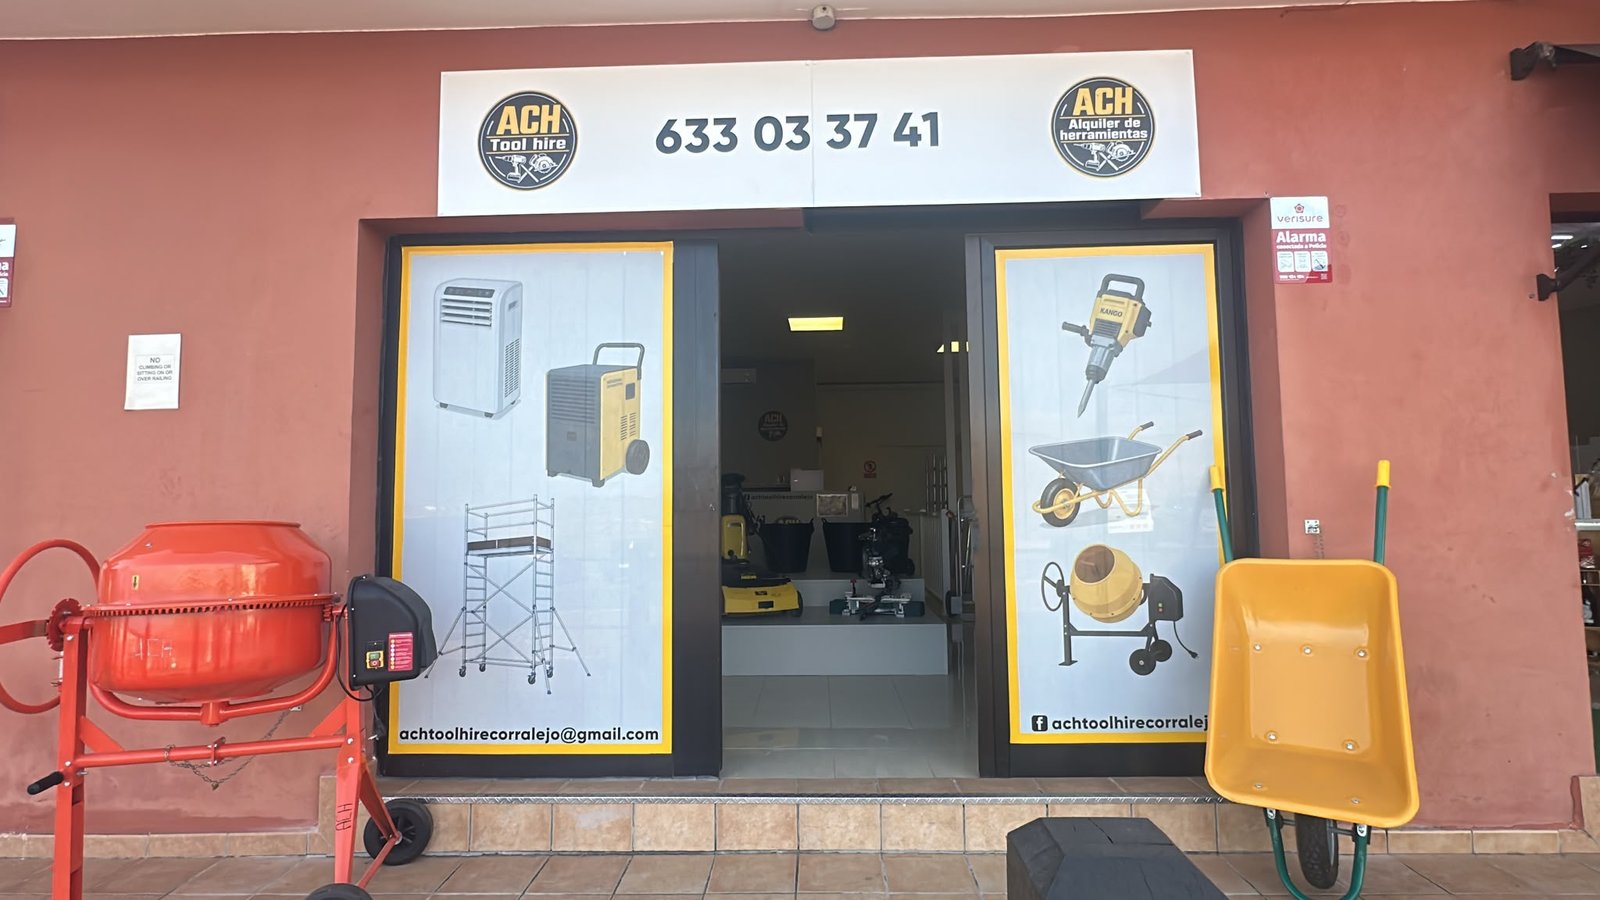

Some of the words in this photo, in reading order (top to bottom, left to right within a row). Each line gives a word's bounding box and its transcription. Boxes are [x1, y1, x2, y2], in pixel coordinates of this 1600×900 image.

[1072, 86, 1133, 116] ACH
[495, 104, 562, 135] ACH
[1068, 118, 1121, 131] Alquiler
[1124, 118, 1141, 128] de
[655, 117, 739, 154] 633
[754, 115, 811, 152] 03
[826, 113, 878, 150] 37
[893, 111, 939, 148] 41
[1059, 128, 1148, 140] herramientas
[489, 137, 527, 151] Tool
[532, 137, 567, 150] hire
[1276, 231, 1326, 243] Alarma
[1100, 307, 1123, 318] KANGO
[1052, 715, 1208, 732] achtoolhirecorralej
[399, 726, 659, 744] achtoolhirecorralejo@gmail.com
